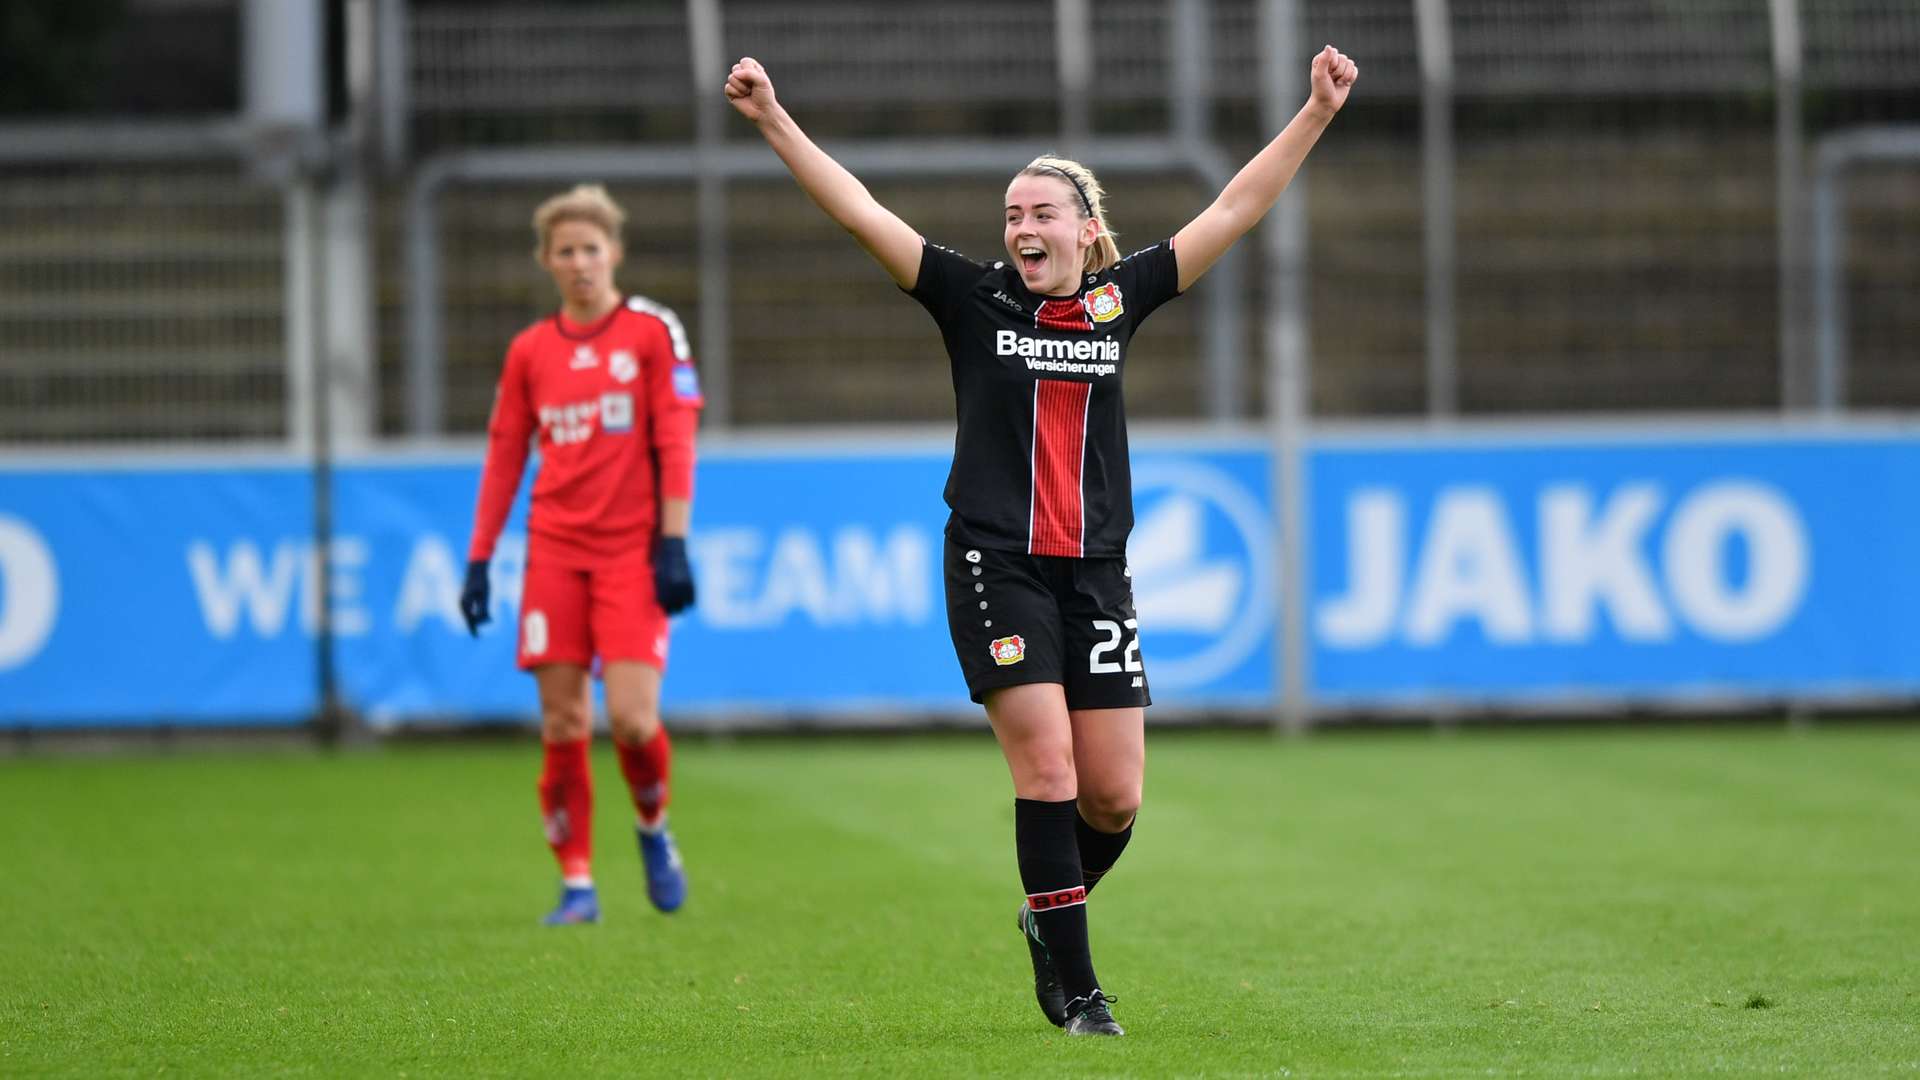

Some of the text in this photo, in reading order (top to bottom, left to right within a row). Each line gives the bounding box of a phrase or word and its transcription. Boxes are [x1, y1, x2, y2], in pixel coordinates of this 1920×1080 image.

[993, 290, 1023, 312] JAKO
[996, 330, 1120, 361] Barmenia
[1025, 357, 1116, 377] Versicherungen
[1316, 478, 1811, 649] JAKO
[186, 535, 372, 639] WE
[1089, 618, 1143, 674] 22
